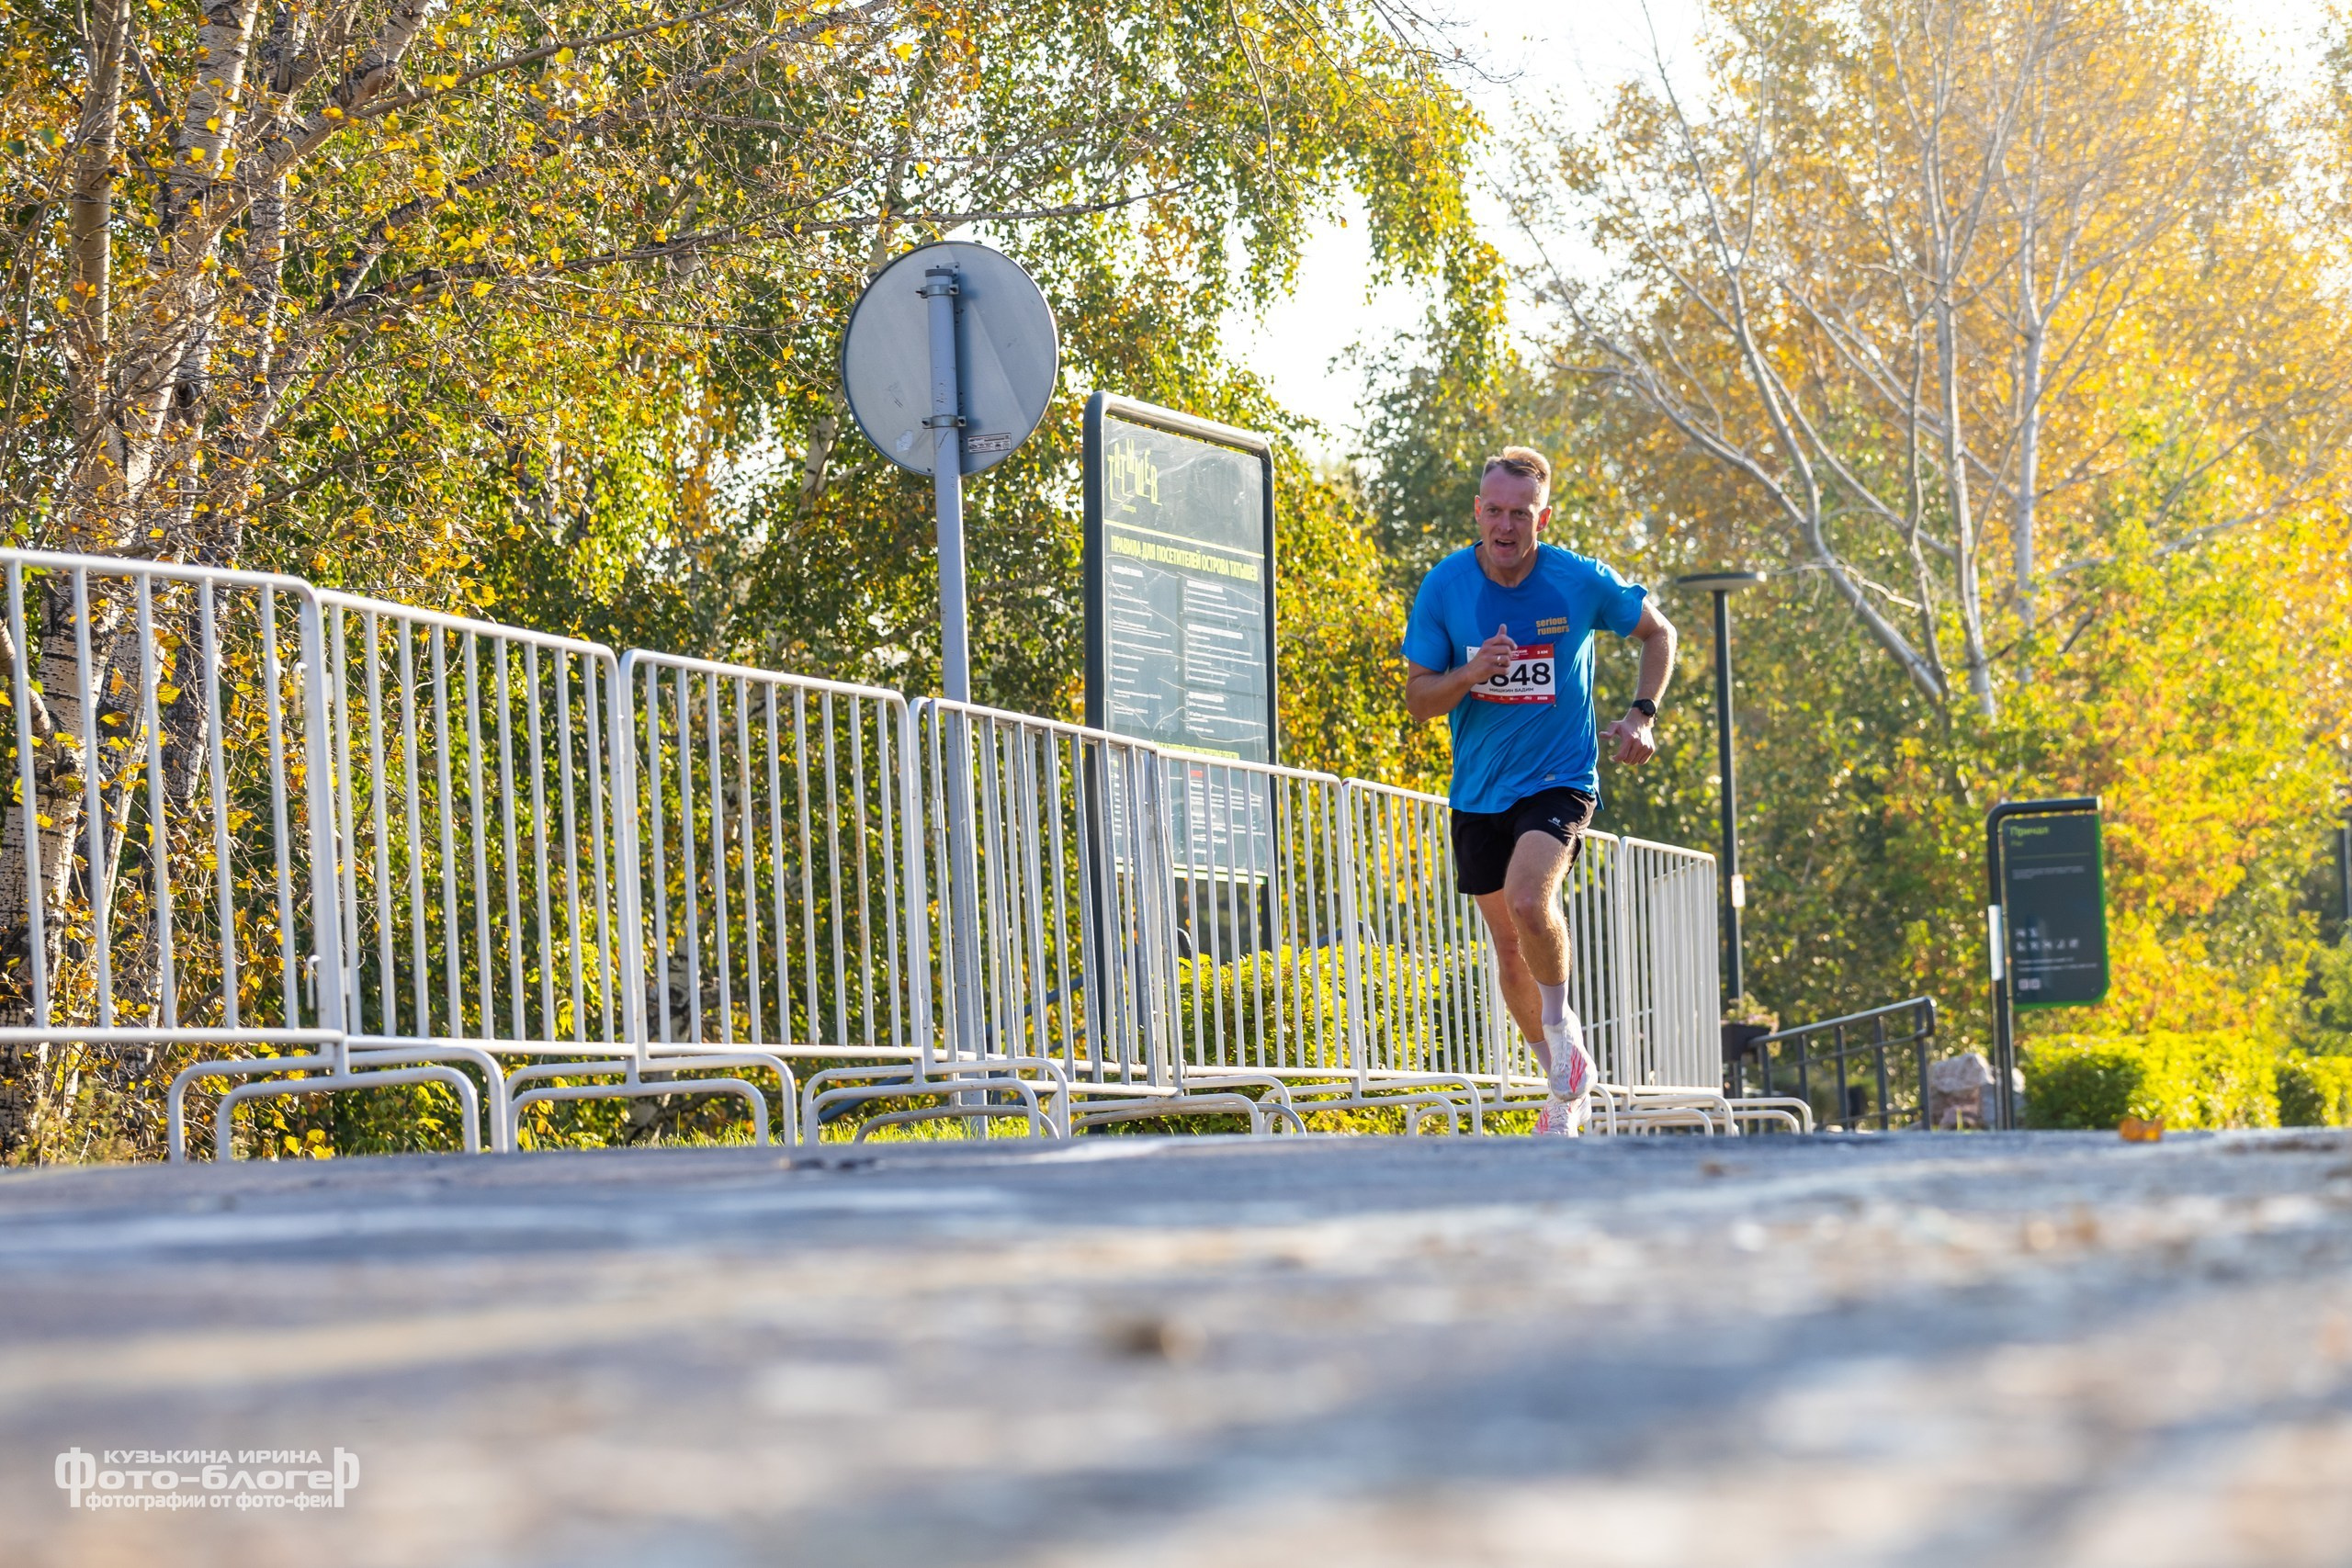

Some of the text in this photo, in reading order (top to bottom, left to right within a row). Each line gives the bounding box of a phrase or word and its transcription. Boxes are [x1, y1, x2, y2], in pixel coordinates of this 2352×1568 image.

[1111, 536, 1141, 558] ПРАВИЛА
[1142, 541, 1156, 561] ДЛЯ
[1157, 545, 1201, 570] ПОСЕТИТЕЛЕЙ
[1202, 554, 1229, 576] ОСТРОВА
[1536, 616, 1567, 627] serious
[1537, 625, 1569, 636] runners
[1476, 662, 1551, 687] 848
